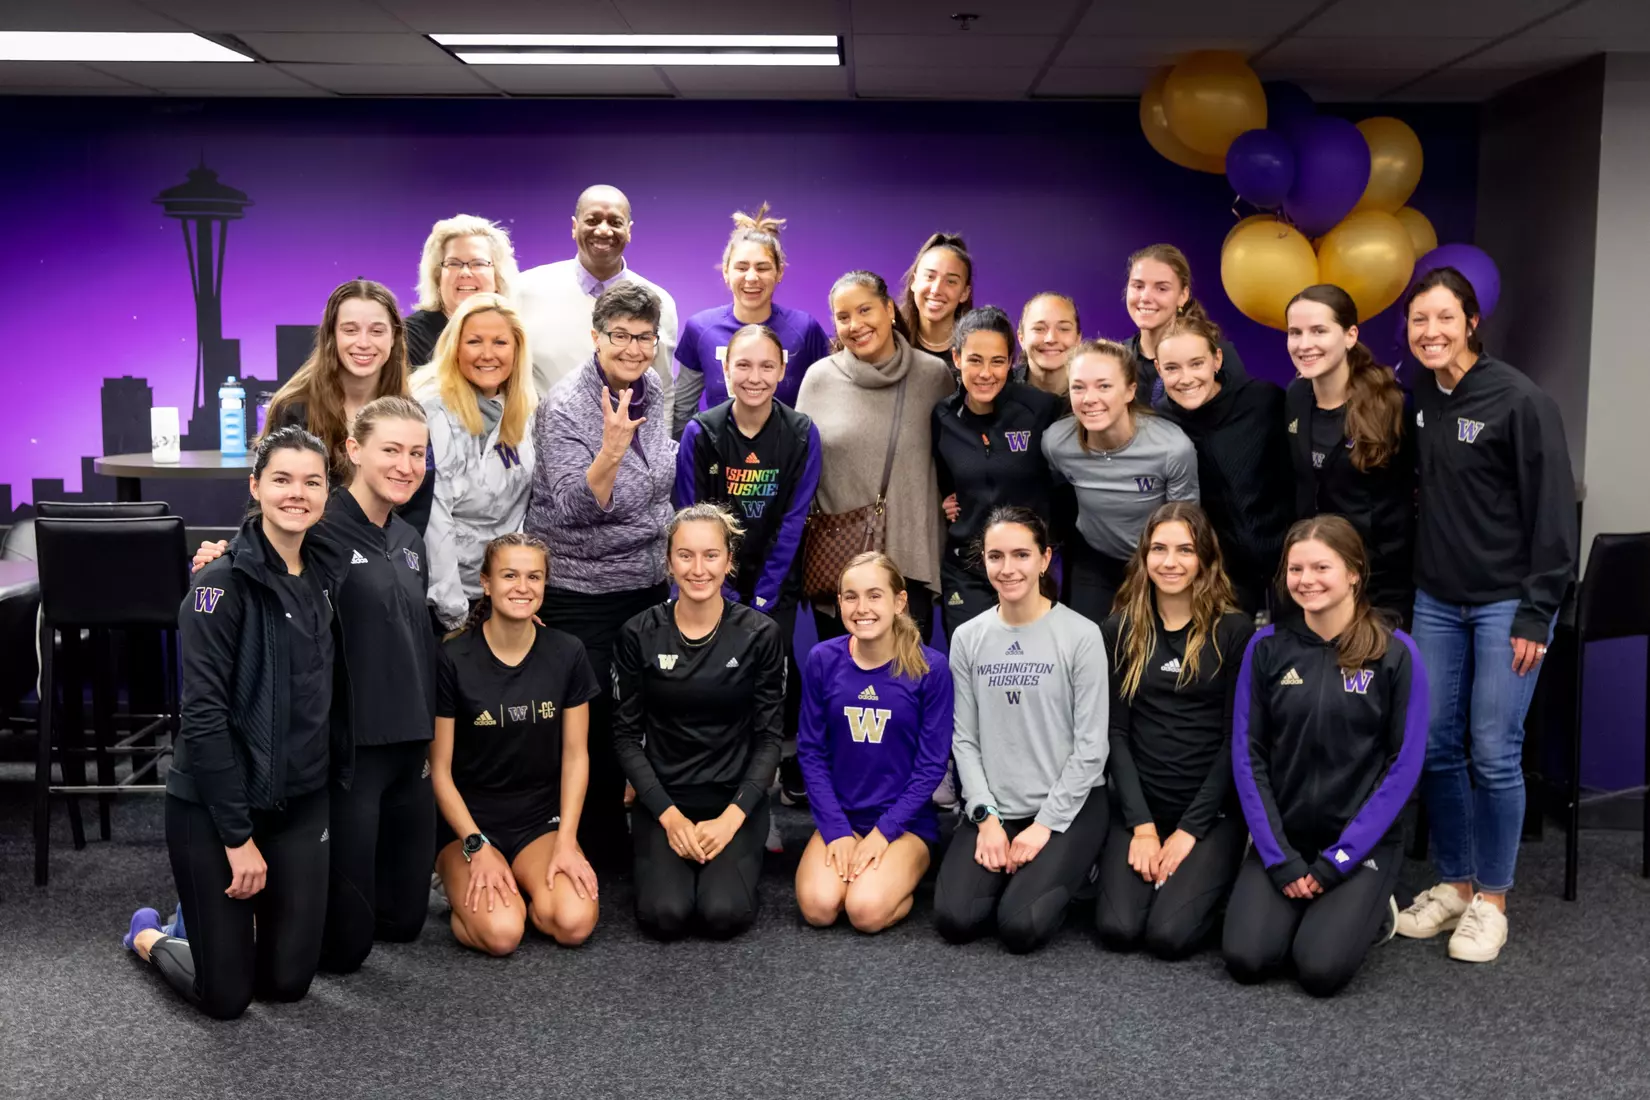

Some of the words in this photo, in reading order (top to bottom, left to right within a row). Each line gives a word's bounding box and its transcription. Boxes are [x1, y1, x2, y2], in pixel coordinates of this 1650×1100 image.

[1457, 417, 1485, 443] W
[1005, 430, 1031, 452] W
[494, 441, 521, 470] W
[726, 481, 779, 496] HUSKIE
[1133, 477, 1156, 493] W
[741, 501, 765, 518] W
[402, 547, 419, 571] W
[194, 587, 224, 613] W
[657, 653, 679, 670] W
[977, 662, 1055, 676] WASHINGTON
[988, 675, 1040, 688] HUSKIES
[1341, 668, 1374, 694] W
[1005, 691, 1021, 705] W
[508, 705, 528, 722] W
[843, 706, 892, 744] W
